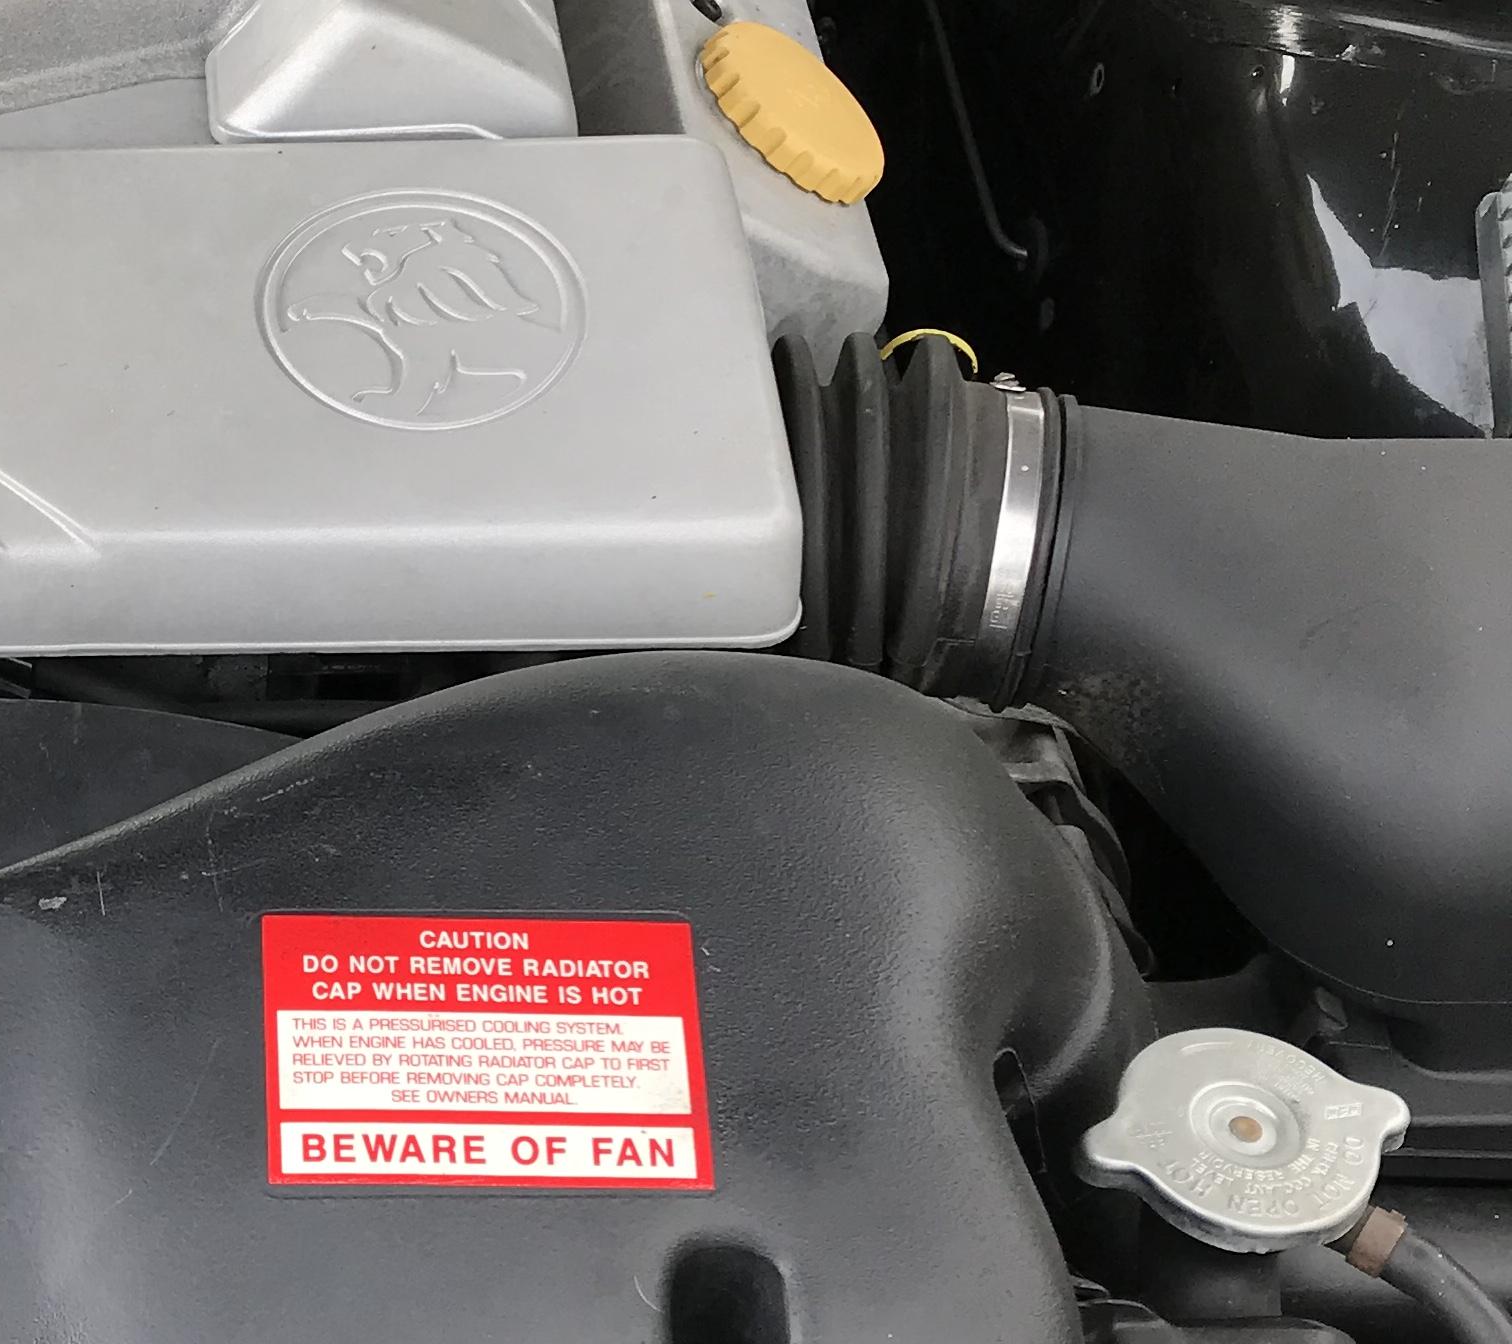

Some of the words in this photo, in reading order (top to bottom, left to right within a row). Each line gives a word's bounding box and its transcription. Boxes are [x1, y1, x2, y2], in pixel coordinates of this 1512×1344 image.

[419, 930, 529, 949] CAUTION
[302, 954, 339, 974] DO
[348, 955, 400, 975] NOT
[409, 956, 513, 977] REMOVE
[522, 958, 650, 979] RADIATOR
[311, 981, 362, 1001] CAP
[372, 982, 446, 1002] WHEN
[456, 983, 545, 1004] ENGINE
[557, 984, 582, 1004] IS
[590, 985, 643, 1005] HOT
[292, 1017, 326, 1030] THIS
[332, 1018, 346, 1031] IS
[352, 1018, 363, 1031] A
[369, 1018, 476, 1032] PRESSURISED
[481, 1020, 550, 1034] COOLING
[293, 1034, 343, 1049] WHEN
[349, 1035, 405, 1050] ENGINE
[412, 1036, 445, 1050] HAS
[522, 1038, 605, 1052] PRESSURE
[611, 1039, 644, 1053] MAY
[650, 1040, 670, 1053] BE
[292, 1052, 365, 1067] RELIEVED
[372, 1054, 393, 1067] BY
[399, 1054, 472, 1068] ROTATING
[478, 1055, 556, 1069] RADIATOR
[561, 1056, 594, 1070] CAP
[600, 1057, 621, 1070] TO
[627, 1057, 669, 1071] FIRST
[292, 1070, 334, 1084] STOP
[340, 1071, 400, 1085] BEFORE
[406, 1072, 490, 1086] REMOVING
[495, 1073, 529, 1087] CAP
[391, 1089, 420, 1103] SEE
[426, 1090, 498, 1104] OWNERS
[301, 1133, 486, 1164] BEWARE
[510, 1136, 568, 1165] OF
[591, 1137, 674, 1166] FAN
